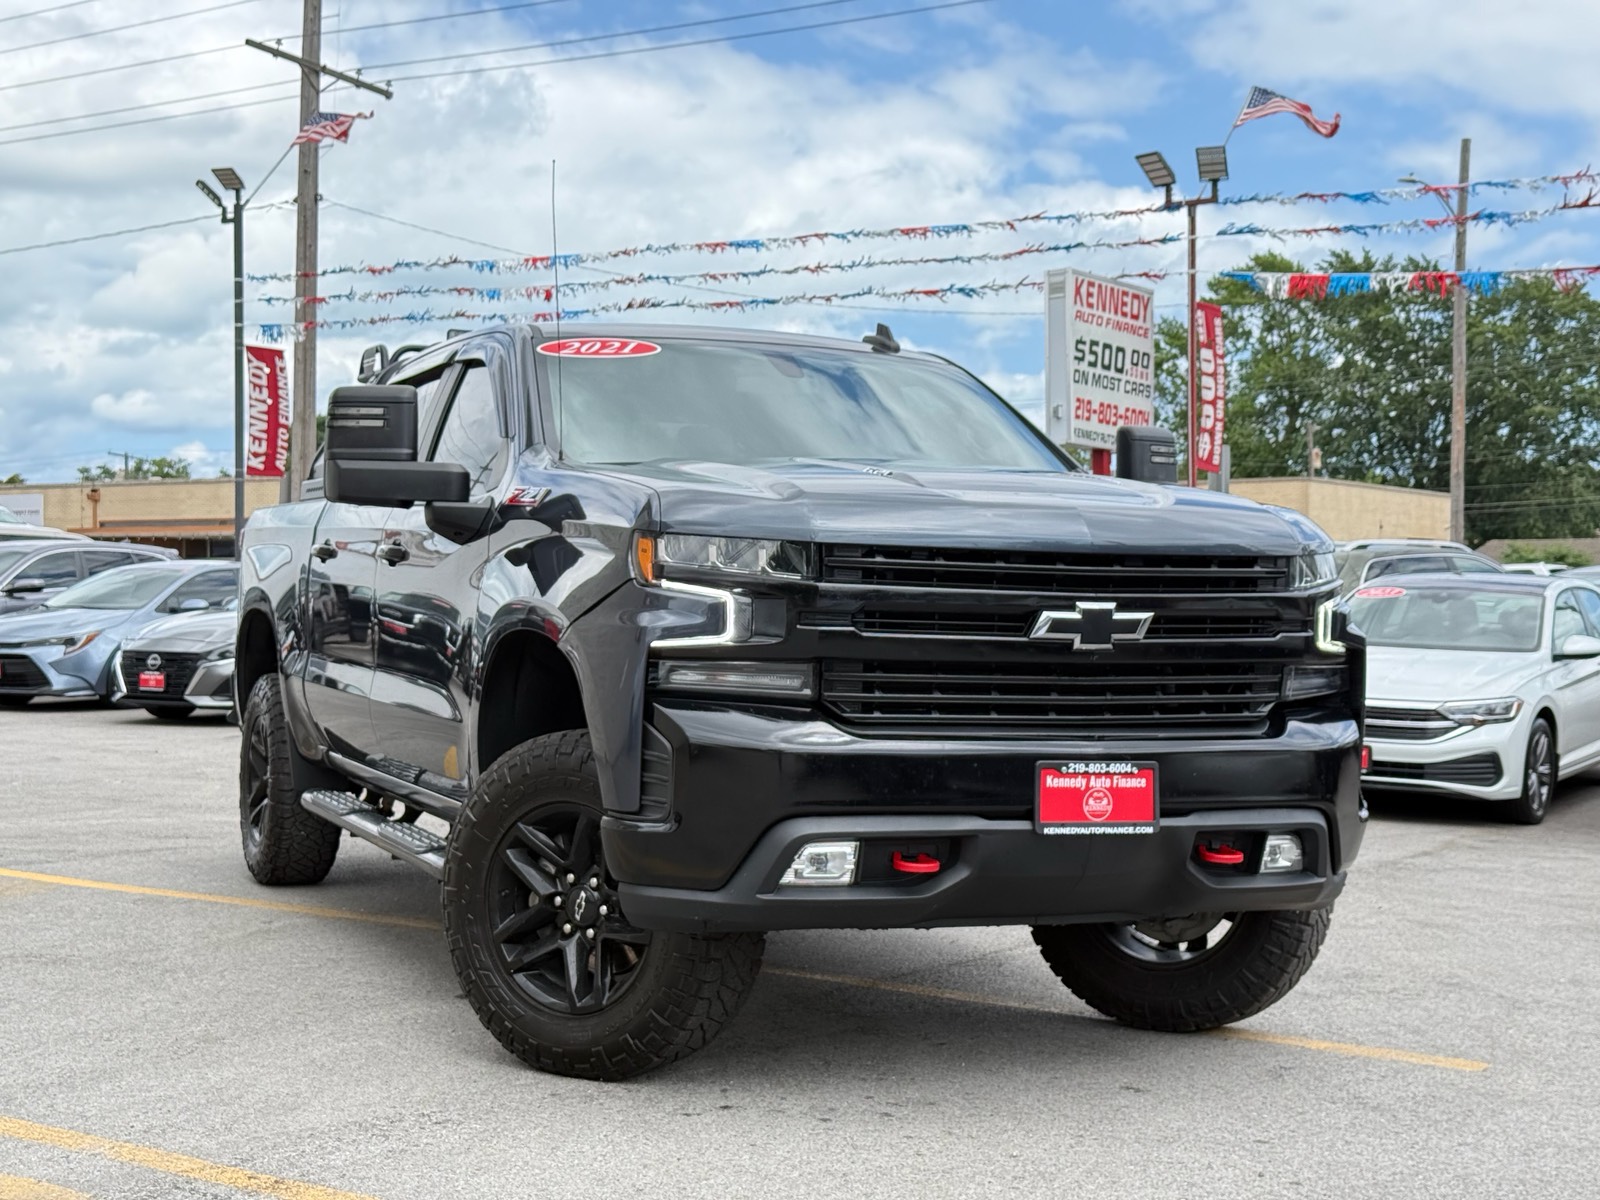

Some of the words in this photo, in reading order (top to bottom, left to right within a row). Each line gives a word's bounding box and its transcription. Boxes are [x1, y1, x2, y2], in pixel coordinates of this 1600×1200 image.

[1073, 276, 1151, 323] KENNEDY
[1074, 310, 1104, 327] AUTO
[1105, 317, 1150, 339] FINANCE
[1213, 316, 1223, 356] CARS
[560, 342, 638, 354] 2021
[274, 356, 290, 426] FINANCE
[1073, 369, 1089, 386] ON
[1091, 373, 1122, 392] MOST
[1124, 380, 1151, 398] CARS
[248, 352, 269, 471] KENNEDY
[275, 428, 289, 471] AUTO
[1068, 763, 1132, 773] 219-803-6004
[1046, 775, 1087, 791] Kennedy
[1089, 776, 1111, 788] Auto
[1113, 775, 1147, 788] Finance
[1043, 826, 1154, 835] KENNEDYAUTOFINANCE.COM
